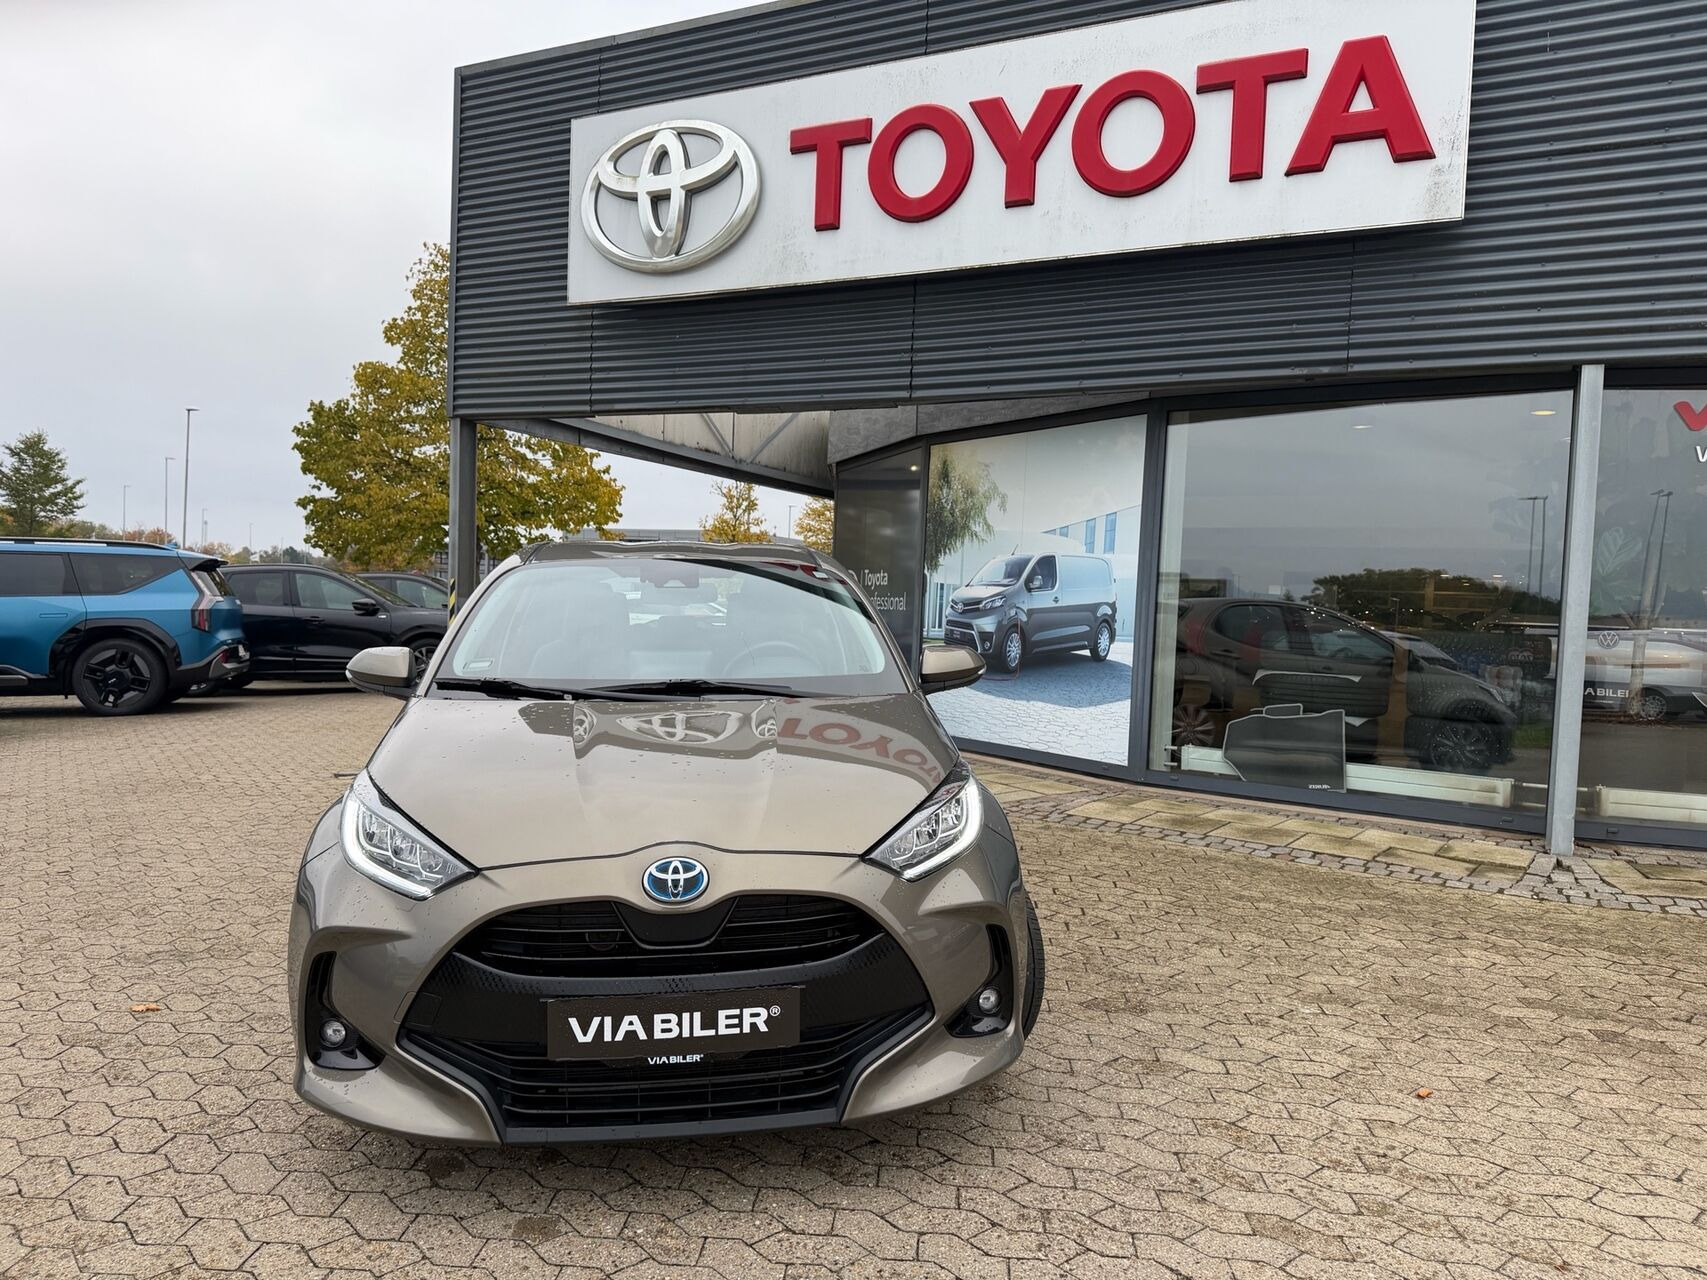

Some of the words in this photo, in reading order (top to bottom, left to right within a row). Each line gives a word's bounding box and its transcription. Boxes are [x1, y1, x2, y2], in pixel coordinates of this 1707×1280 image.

[790, 35, 1435, 231] TOYOTA
[864, 569, 889, 590] Toyota
[567, 1014, 648, 1043] VIA
[647, 1056, 669, 1065] VIA
